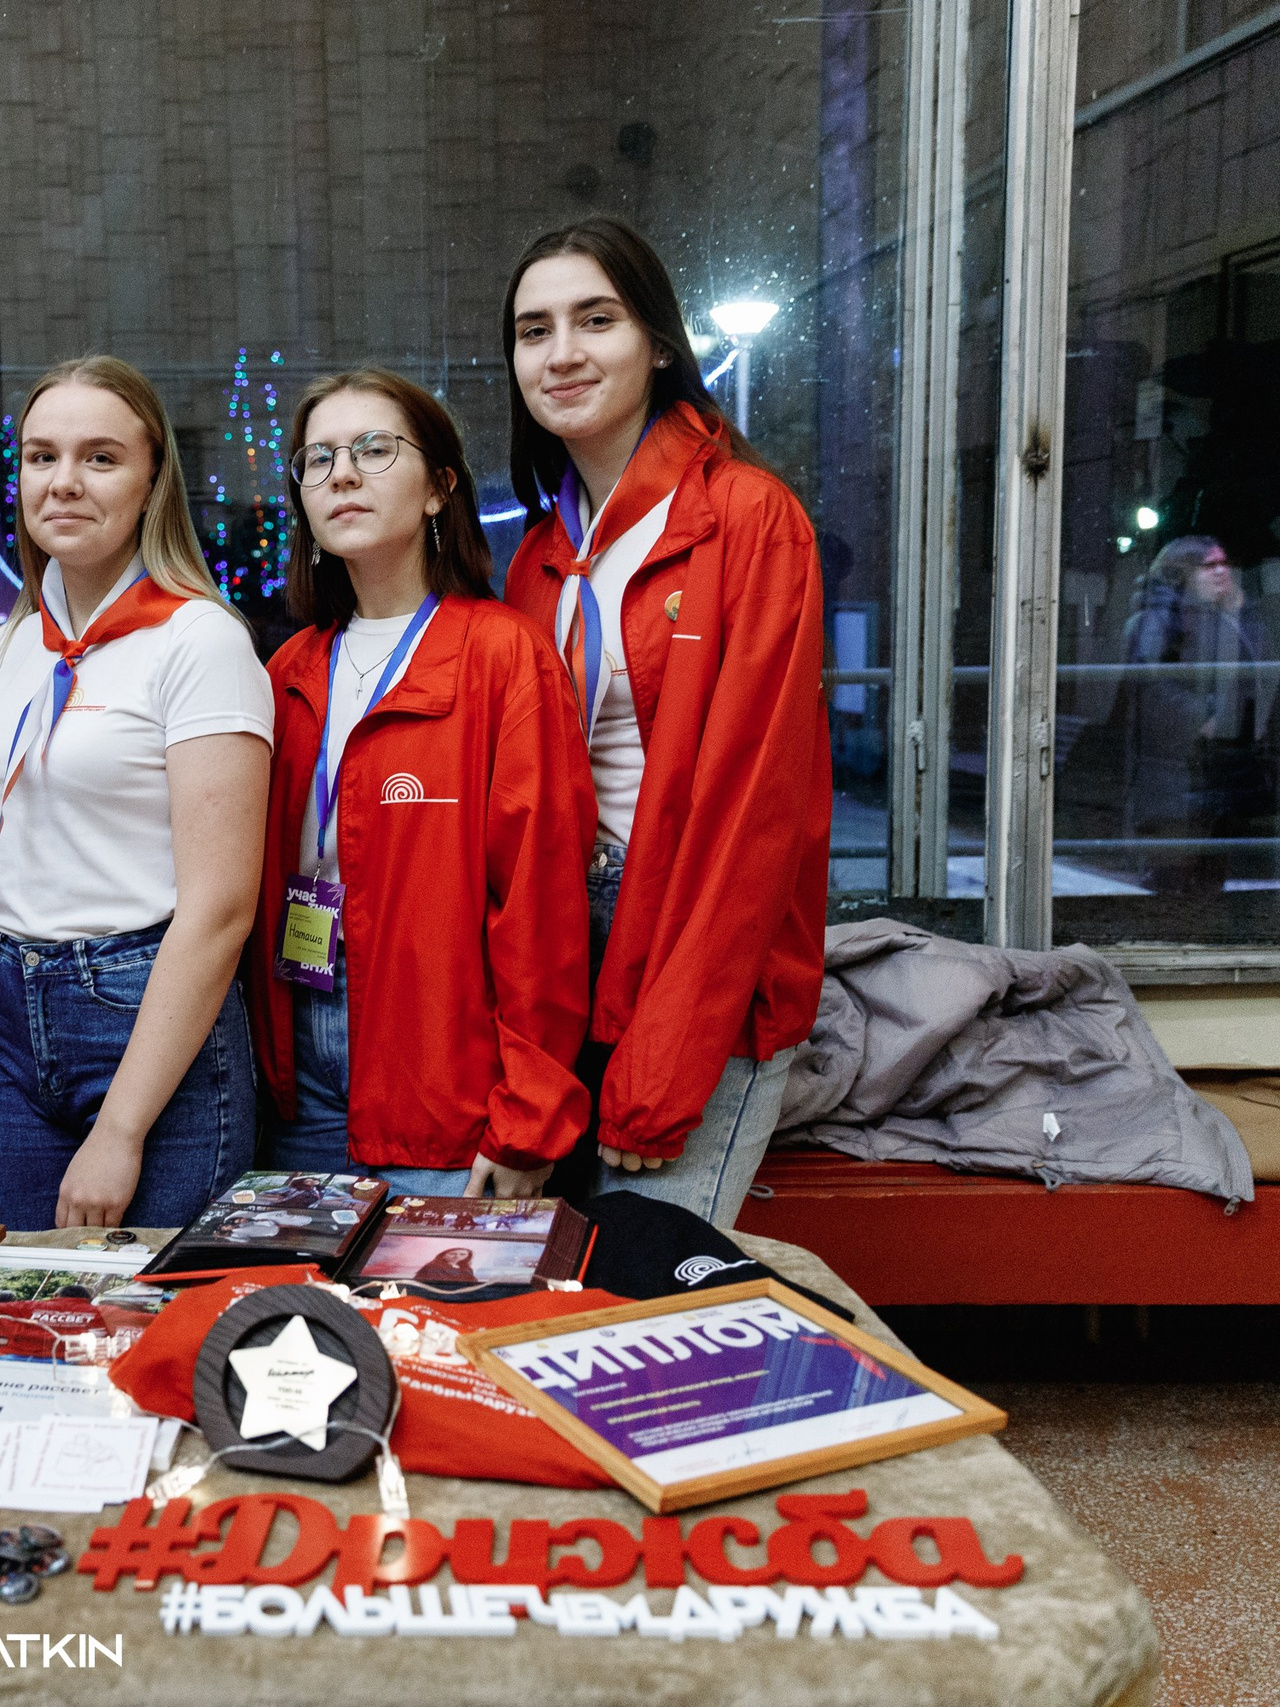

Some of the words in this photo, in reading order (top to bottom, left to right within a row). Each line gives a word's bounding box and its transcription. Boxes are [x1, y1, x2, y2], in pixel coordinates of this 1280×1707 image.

[289, 923, 323, 945] Наташа
[29, 1312, 96, 1324] РАССВЕТ
[513, 1310, 827, 1389] ДИПЛОМ
[27, 1384, 102, 1396] рассвет
[77, 1489, 1024, 1617] #Дружба
